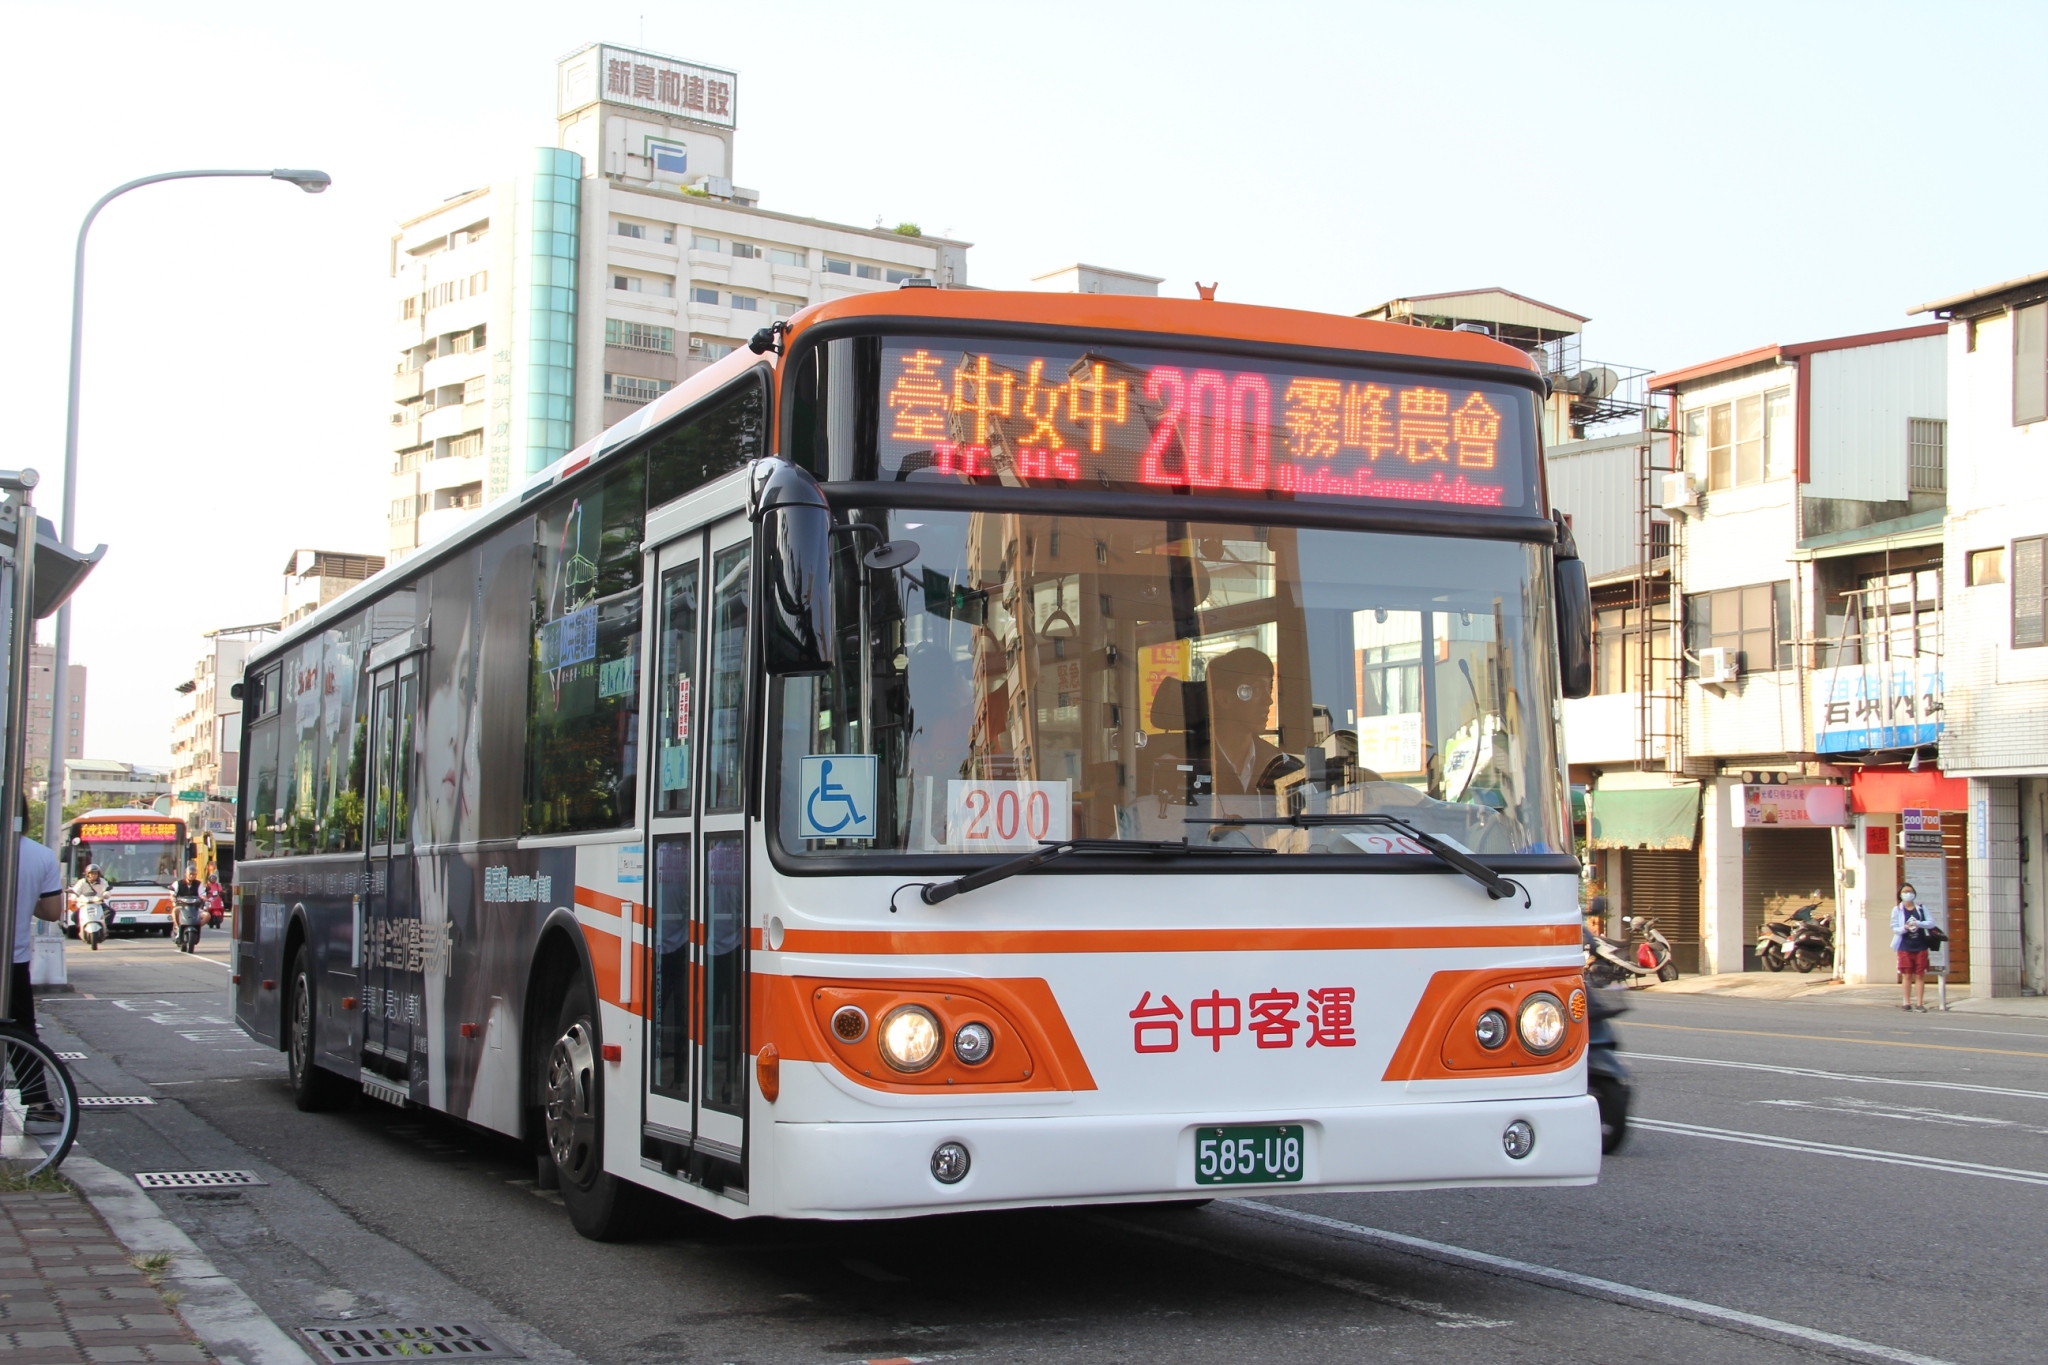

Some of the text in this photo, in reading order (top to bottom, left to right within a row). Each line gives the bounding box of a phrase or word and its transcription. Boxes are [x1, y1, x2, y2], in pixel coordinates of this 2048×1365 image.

[888, 349, 1128, 453] 臺中女中
[1141, 366, 1271, 490] 200
[1284, 376, 1502, 470] 霧峰農會
[964, 789, 1050, 841] 200
[1904, 816, 1940, 825] 200 700
[1128, 986, 1357, 1054] 台中客運
[1199, 1136, 1300, 1176] 585-U8
